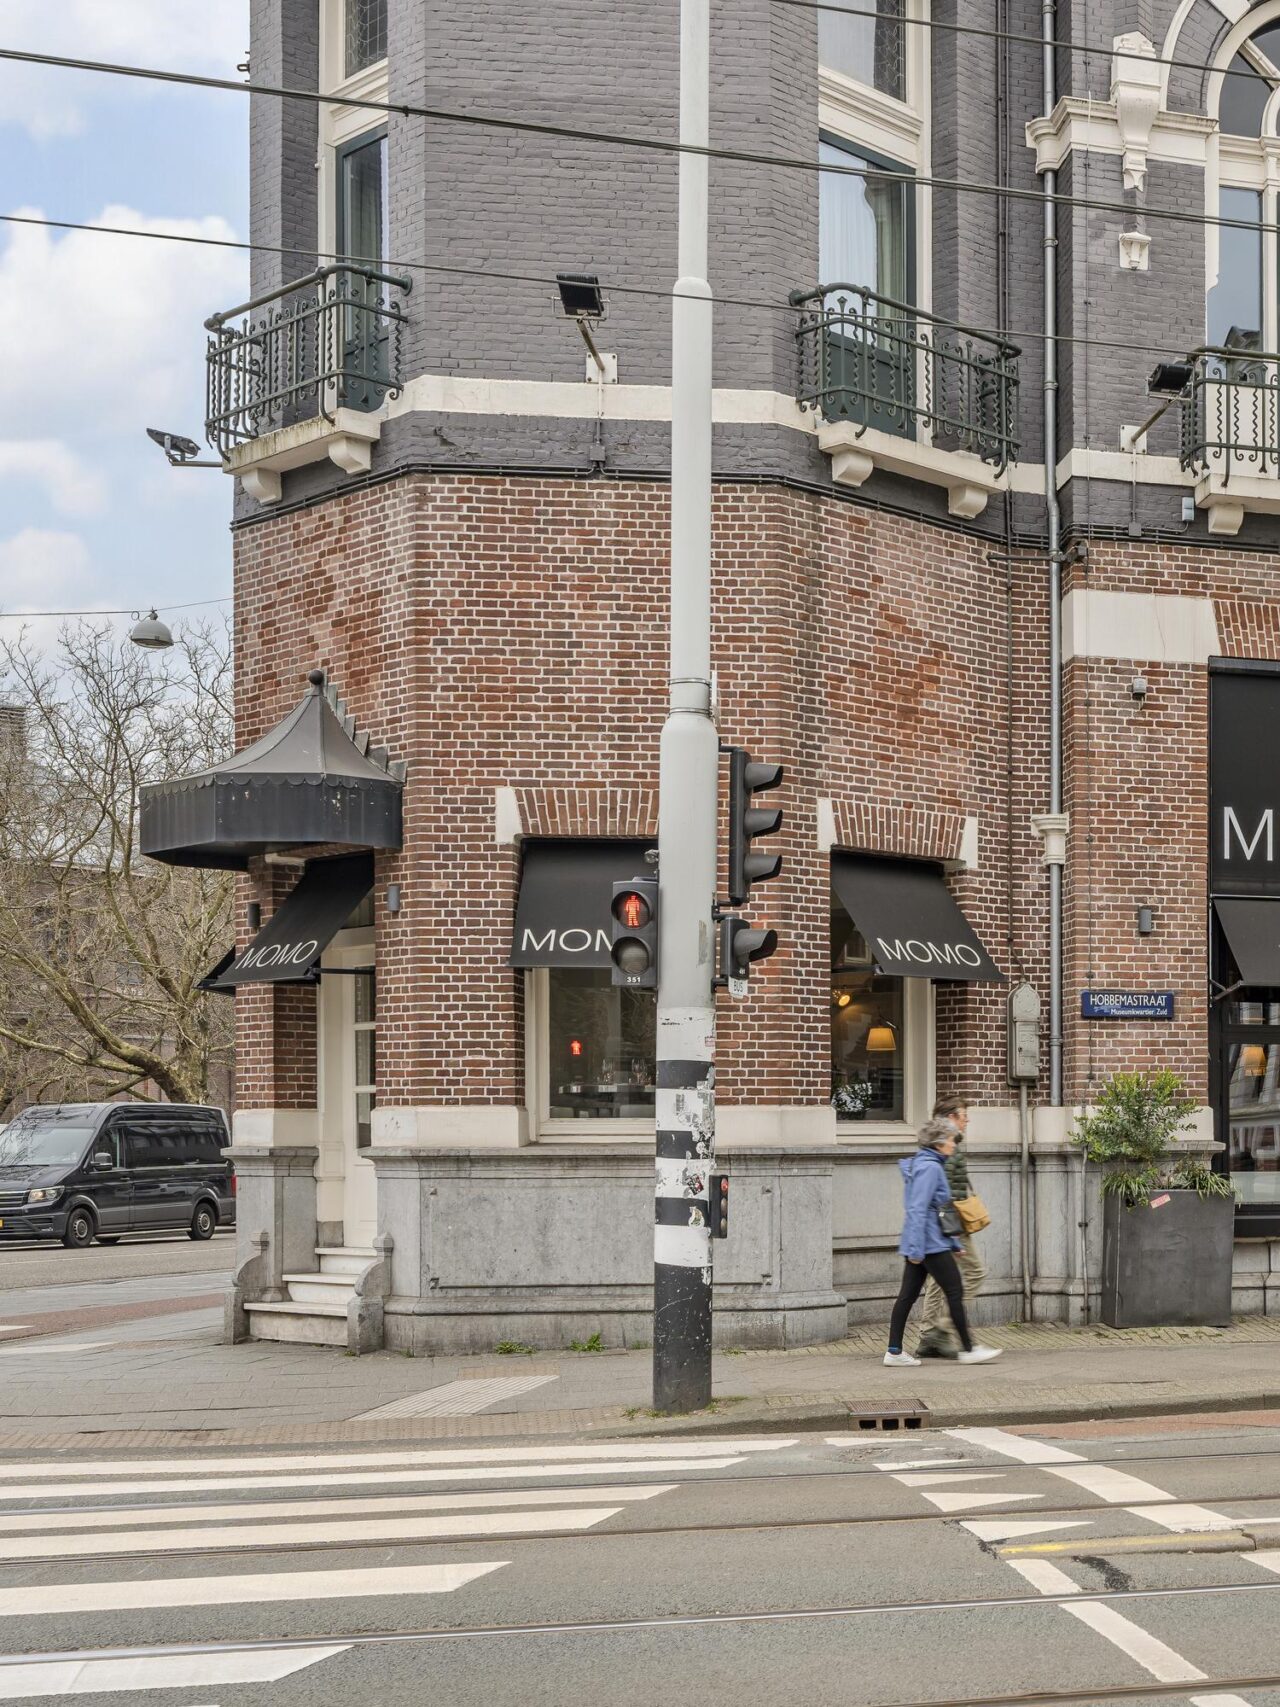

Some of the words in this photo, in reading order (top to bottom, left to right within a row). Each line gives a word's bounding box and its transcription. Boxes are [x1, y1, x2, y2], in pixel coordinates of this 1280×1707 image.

[234, 940, 318, 970] MOMO
[877, 937, 981, 967] MOMO
[1090, 994, 1168, 1007] HOBBEMASTRAAT
